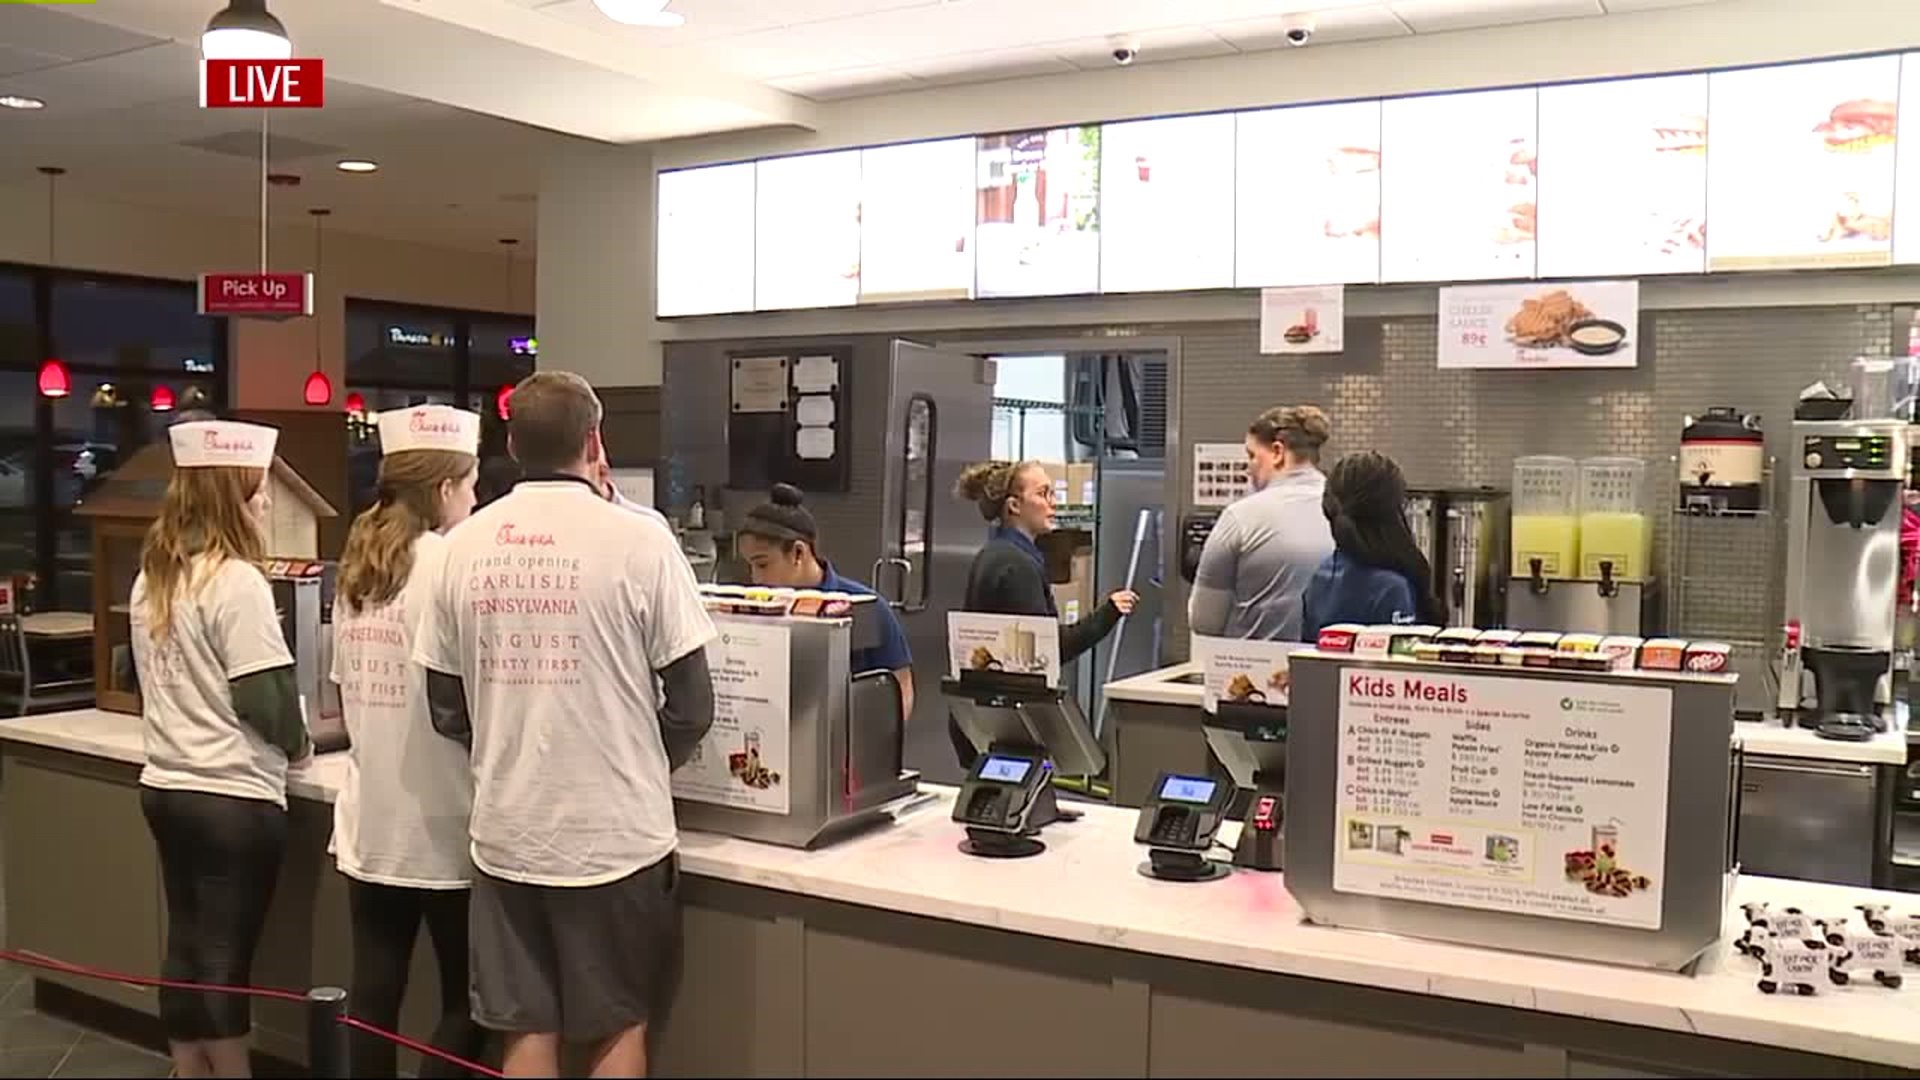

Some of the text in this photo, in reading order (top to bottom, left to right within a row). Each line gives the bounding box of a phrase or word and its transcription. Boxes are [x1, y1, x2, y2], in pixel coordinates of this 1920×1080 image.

[222, 280, 286, 300] Pick Up
[471, 554, 580, 572] grand opening
[470, 575, 579, 591] CARLISLE
[471, 599, 578, 616] PENNSYLVANIA
[1349, 675, 1468, 703] Kids Meals
[1347, 725, 1356, 735] A
[1465, 719, 1491, 732] Sides
[1564, 727, 1598, 740] Drinks
